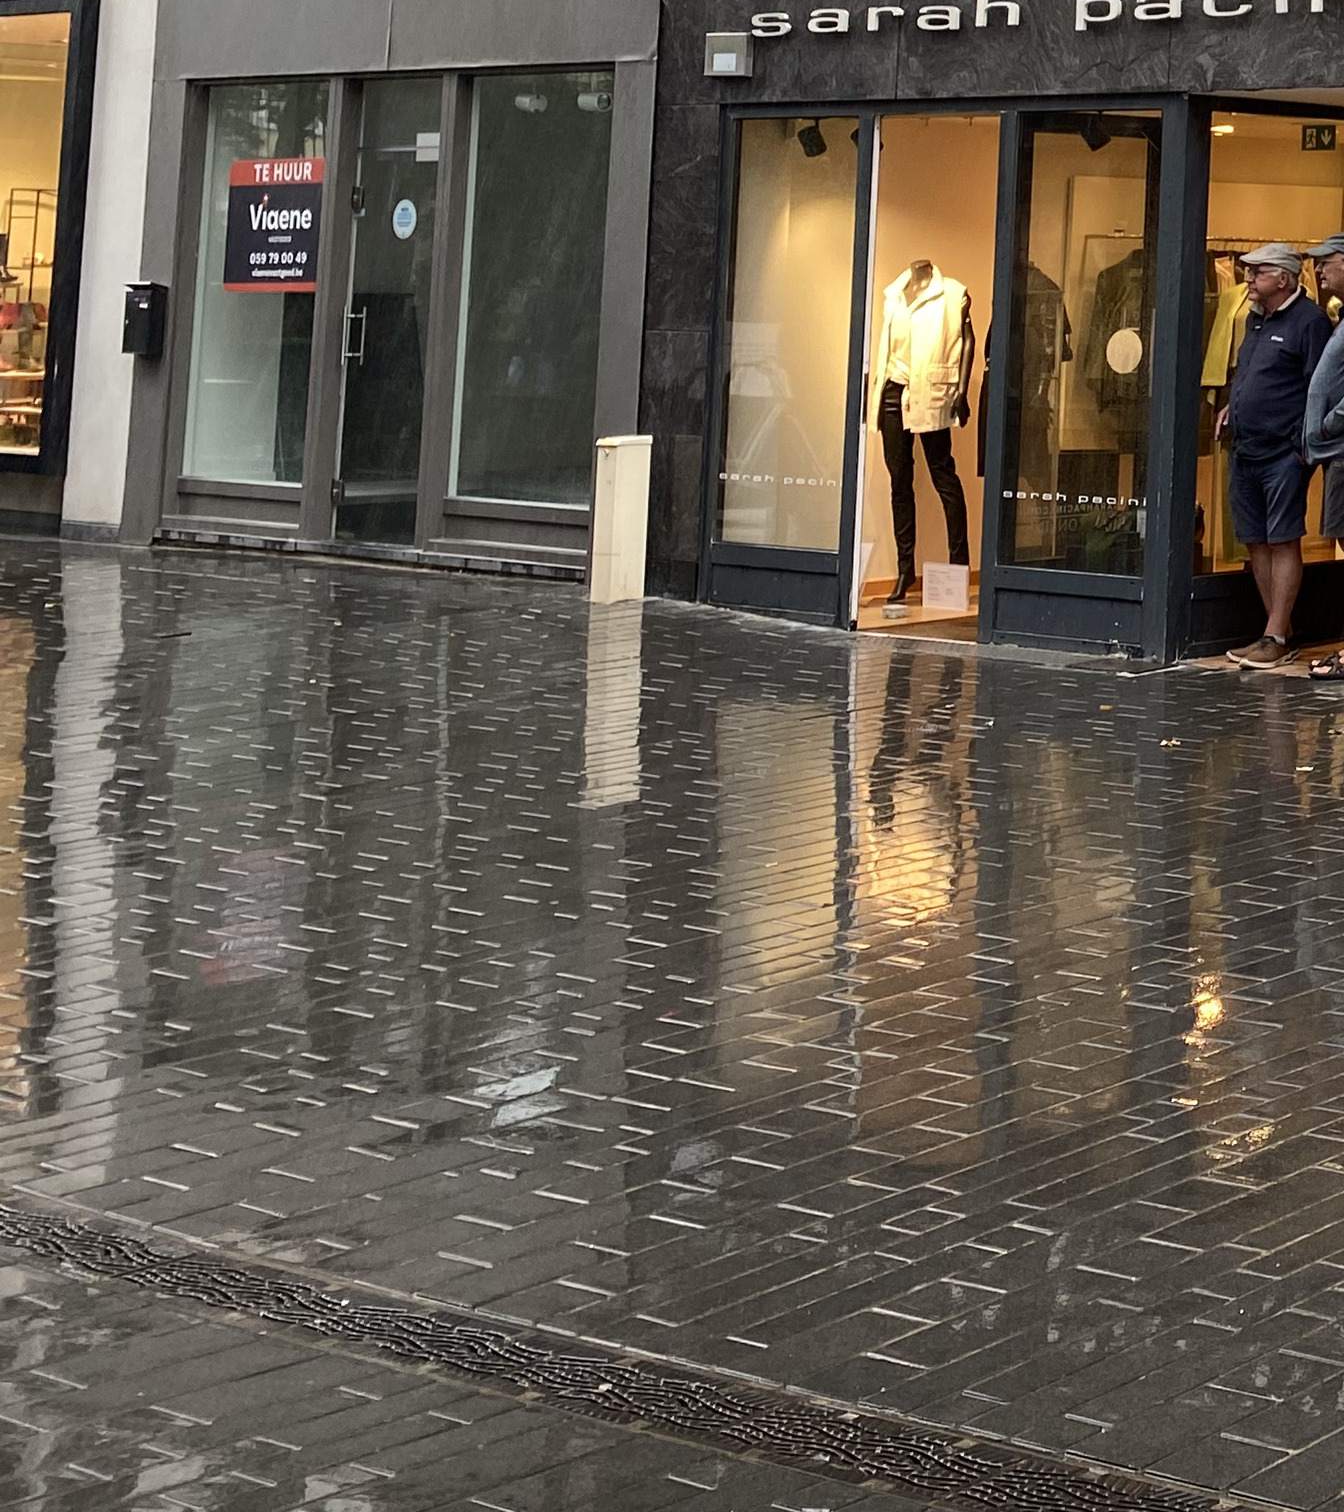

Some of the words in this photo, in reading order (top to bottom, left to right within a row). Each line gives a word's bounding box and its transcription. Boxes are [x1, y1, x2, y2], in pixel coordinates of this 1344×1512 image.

[253, 164, 269, 182] TE
[273, 162, 312, 181] HUUR
[250, 200, 312, 231] Viaene
[250, 252, 267, 264] 059
[268, 252, 279, 264] 79
[280, 252, 293, 264] 00
[295, 251, 307, 264] 49
